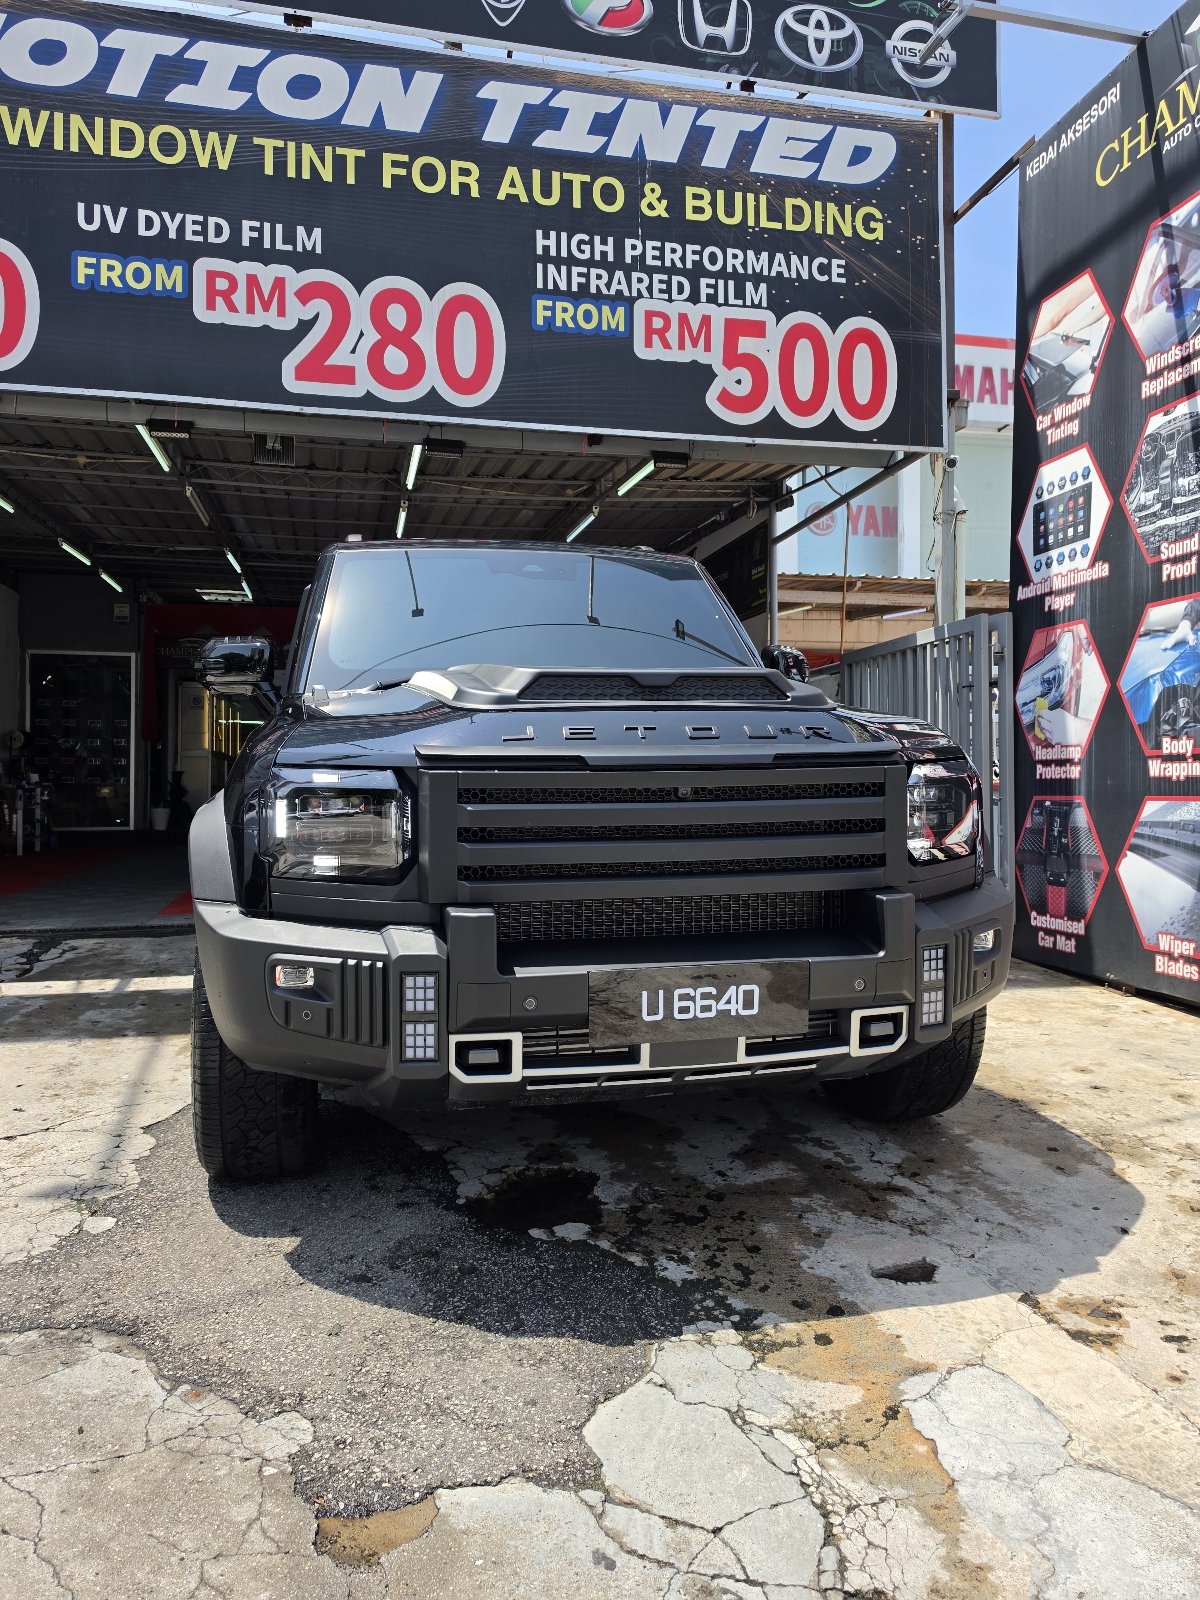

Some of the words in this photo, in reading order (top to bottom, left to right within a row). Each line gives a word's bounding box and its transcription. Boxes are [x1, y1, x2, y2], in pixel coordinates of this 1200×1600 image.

[893, 45, 949, 62] NISN
[0, 13, 443, 133] OTION
[477, 81, 897, 186] TINTED
[1026, 141, 1057, 181] KEDAI
[1059, 82, 1120, 152] AKSESORI
[1162, 122, 1192, 154] AUTO
[0, 105, 237, 170] WINDOW
[253, 136, 366, 185] TINT
[382, 152, 480, 198] FOR
[497, 166, 625, 213] AUTO
[641, 182, 669, 218] &
[686, 186, 884, 242] BUILDING
[76, 202, 128, 233] UV
[137, 208, 230, 244] DYED
[242, 219, 323, 254] FILM
[535, 229, 614, 263] HIGH
[625, 236, 847, 284] PERFORMANCE
[535, 262, 691, 302] INFRARED
[700, 277, 768, 308] FILM
[75, 255, 184, 293] FROM
[204, 267, 496, 397] RM280
[535, 299, 626, 332] FROM
[643, 309, 889, 422] RM500
[1036, 411, 1052, 432] Car
[1053, 393, 1091, 424] Window
[1046, 418, 1079, 445] Tinting
[847, 504, 898, 538] YAM
[1160, 533, 1199, 560] Sound
[1017, 577, 1051, 601] Android
[1050, 561, 1109, 592] Multimedia
[1162, 556, 1197, 582] Proof
[1044, 591, 1075, 612] Player
[502, 724, 833, 743] JETOUR
[1162, 735, 1194, 758] Body
[1035, 744, 1081, 762] Headlamp
[1036, 763, 1081, 780] Protector
[1148, 758, 1200, 782] Wrappin
[1030, 911, 1085, 936] Customised
[1038, 931, 1055, 949] Car
[1056, 934, 1076, 954] Mat
[1158, 933, 1196, 957] Wiper
[1155, 956, 1199, 980] Blades
[641, 989, 664, 1022] U
[673, 984, 760, 1019] 6640
